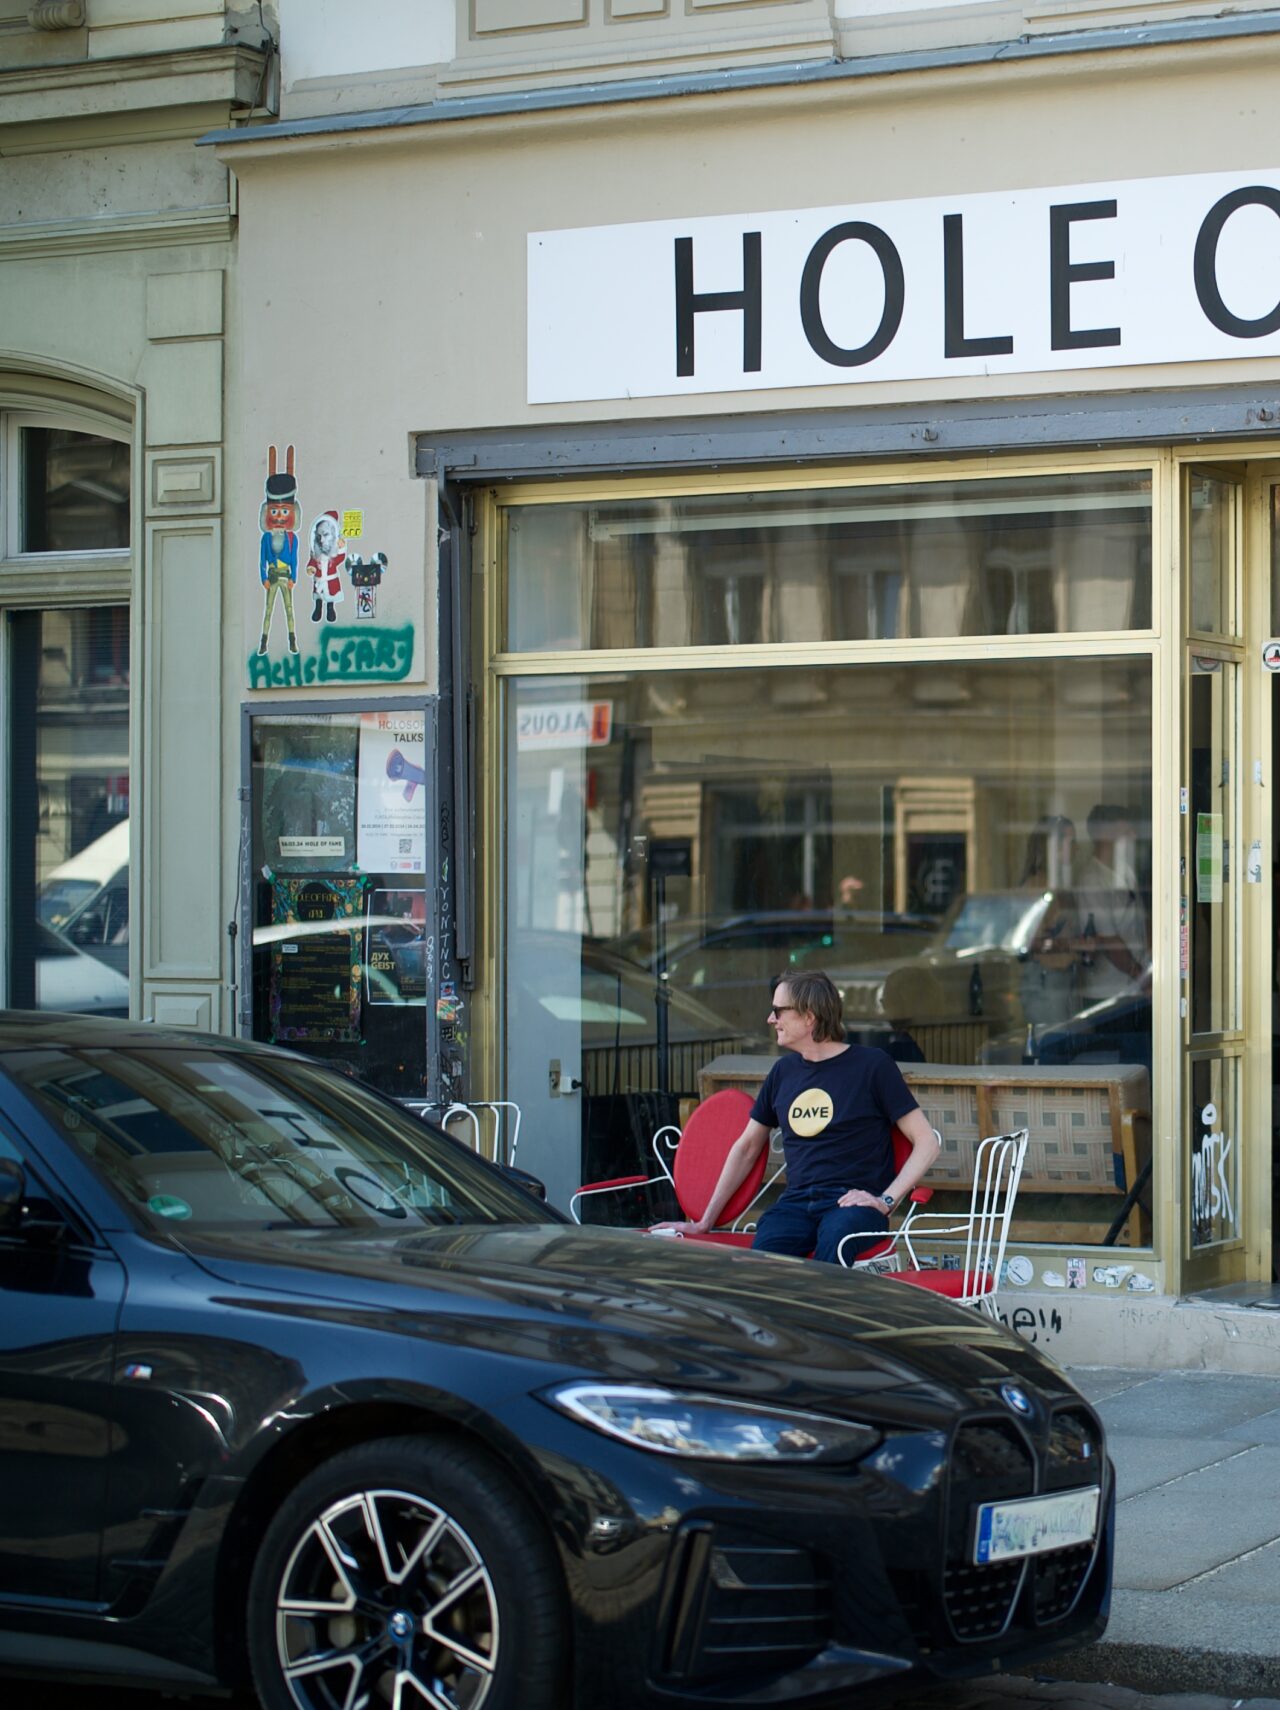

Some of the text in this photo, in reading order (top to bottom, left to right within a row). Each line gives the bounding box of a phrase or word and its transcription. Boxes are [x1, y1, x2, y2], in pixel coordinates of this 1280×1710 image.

[674, 199, 1121, 377] HOLE
[393, 733, 424, 742] TALKS
[371, 952, 389, 962] ДУХ
[371, 961, 396, 970] GEIST
[792, 1106, 829, 1118] DAVE
